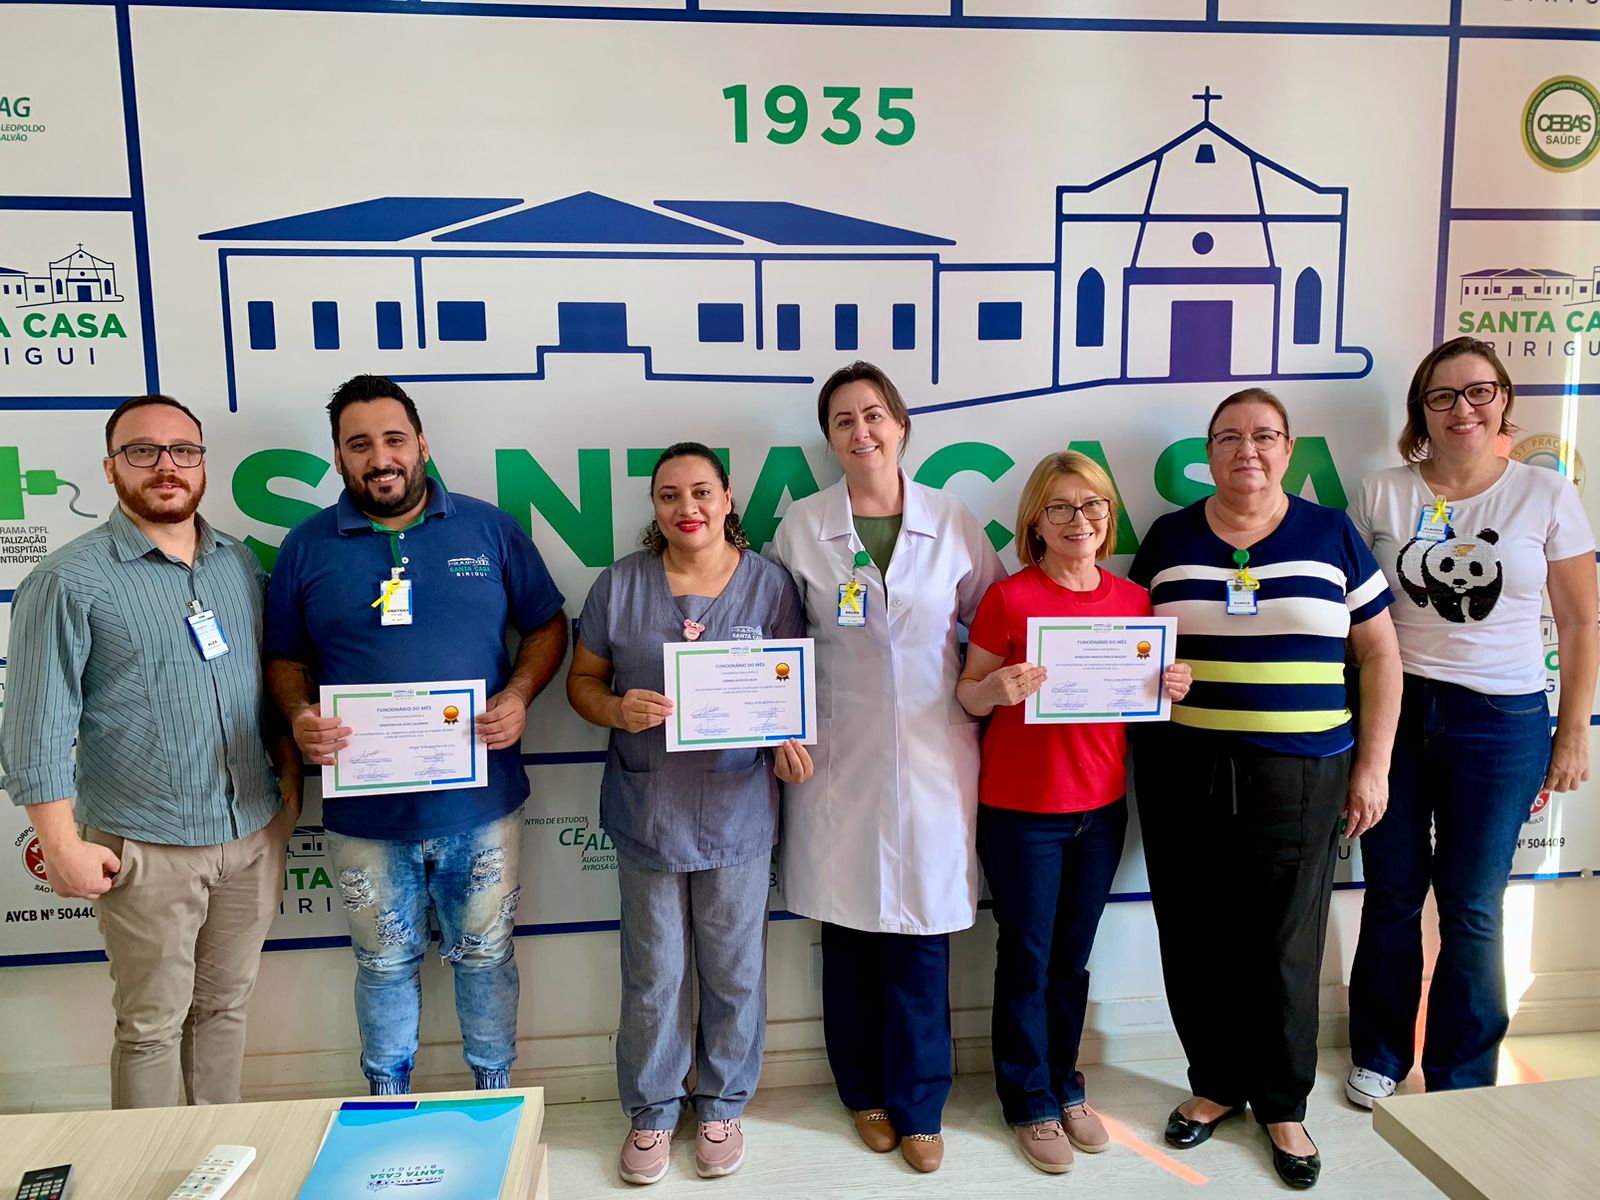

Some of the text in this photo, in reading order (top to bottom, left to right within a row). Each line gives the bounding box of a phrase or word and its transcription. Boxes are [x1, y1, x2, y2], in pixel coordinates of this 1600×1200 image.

[722, 84, 916, 146] 1935
[1, 124, 46, 132] LEOPOLDO
[1537, 113, 1592, 133] CEBAS
[1545, 132, 1582, 145] SAÚDE
[23, 312, 127, 339] CASA
[1458, 310, 1556, 334] SANTA
[4, 347, 95, 365] IGUI
[231, 445, 820, 577] SNA
[29, 526, 49, 534] CPFL
[2, 545, 48, 554] HOSPITAIS
[731, 632, 752, 640] SANTA
[545, 817, 556, 825] DE
[557, 816, 589, 824] ESTUDOS
[14, 826, 35, 847] CORPO
[558, 827, 616, 851] CEAL
[1527, 836, 1566, 849] 504409
[581, 855, 616, 863] AUGUSTO
[581, 863, 609, 871] AYROSA
[5, 910, 37, 922] AVCB
[41, 908, 54, 921] Nº
[370, 1168, 445, 1180] SANTA CASA
[381, 1164, 437, 1173] BIRIGUI
